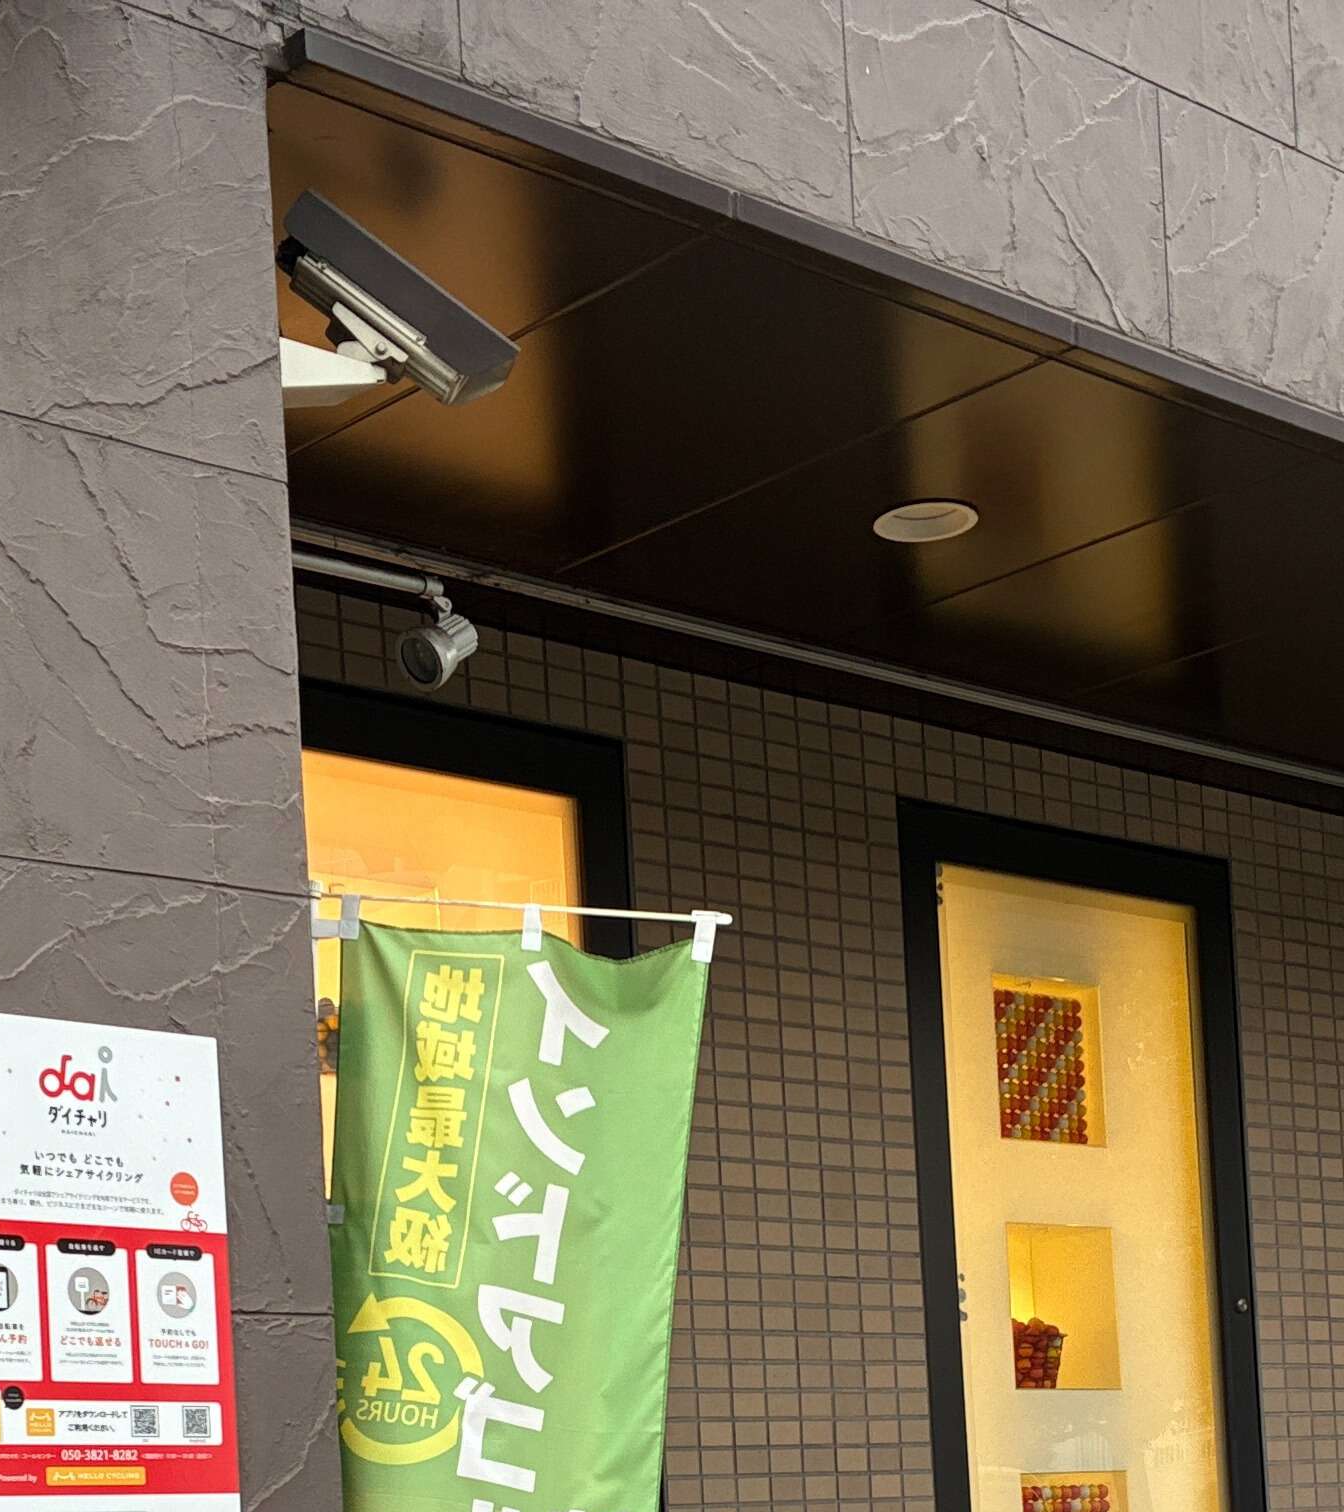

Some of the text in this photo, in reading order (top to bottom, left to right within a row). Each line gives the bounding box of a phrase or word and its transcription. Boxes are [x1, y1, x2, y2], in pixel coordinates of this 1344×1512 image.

[49, 1106, 107, 1128] ダイチャリ
[35, 1151, 124, 1167] いつでも どこでも
[20, 1164, 143, 1183] 気軽にシェアサイクリング
[60, 1336, 122, 1347] どこでも返せる
[148, 1339, 183, 1349] TOUCH
[60, 1449, 138, 1461] 050-3821-8282
